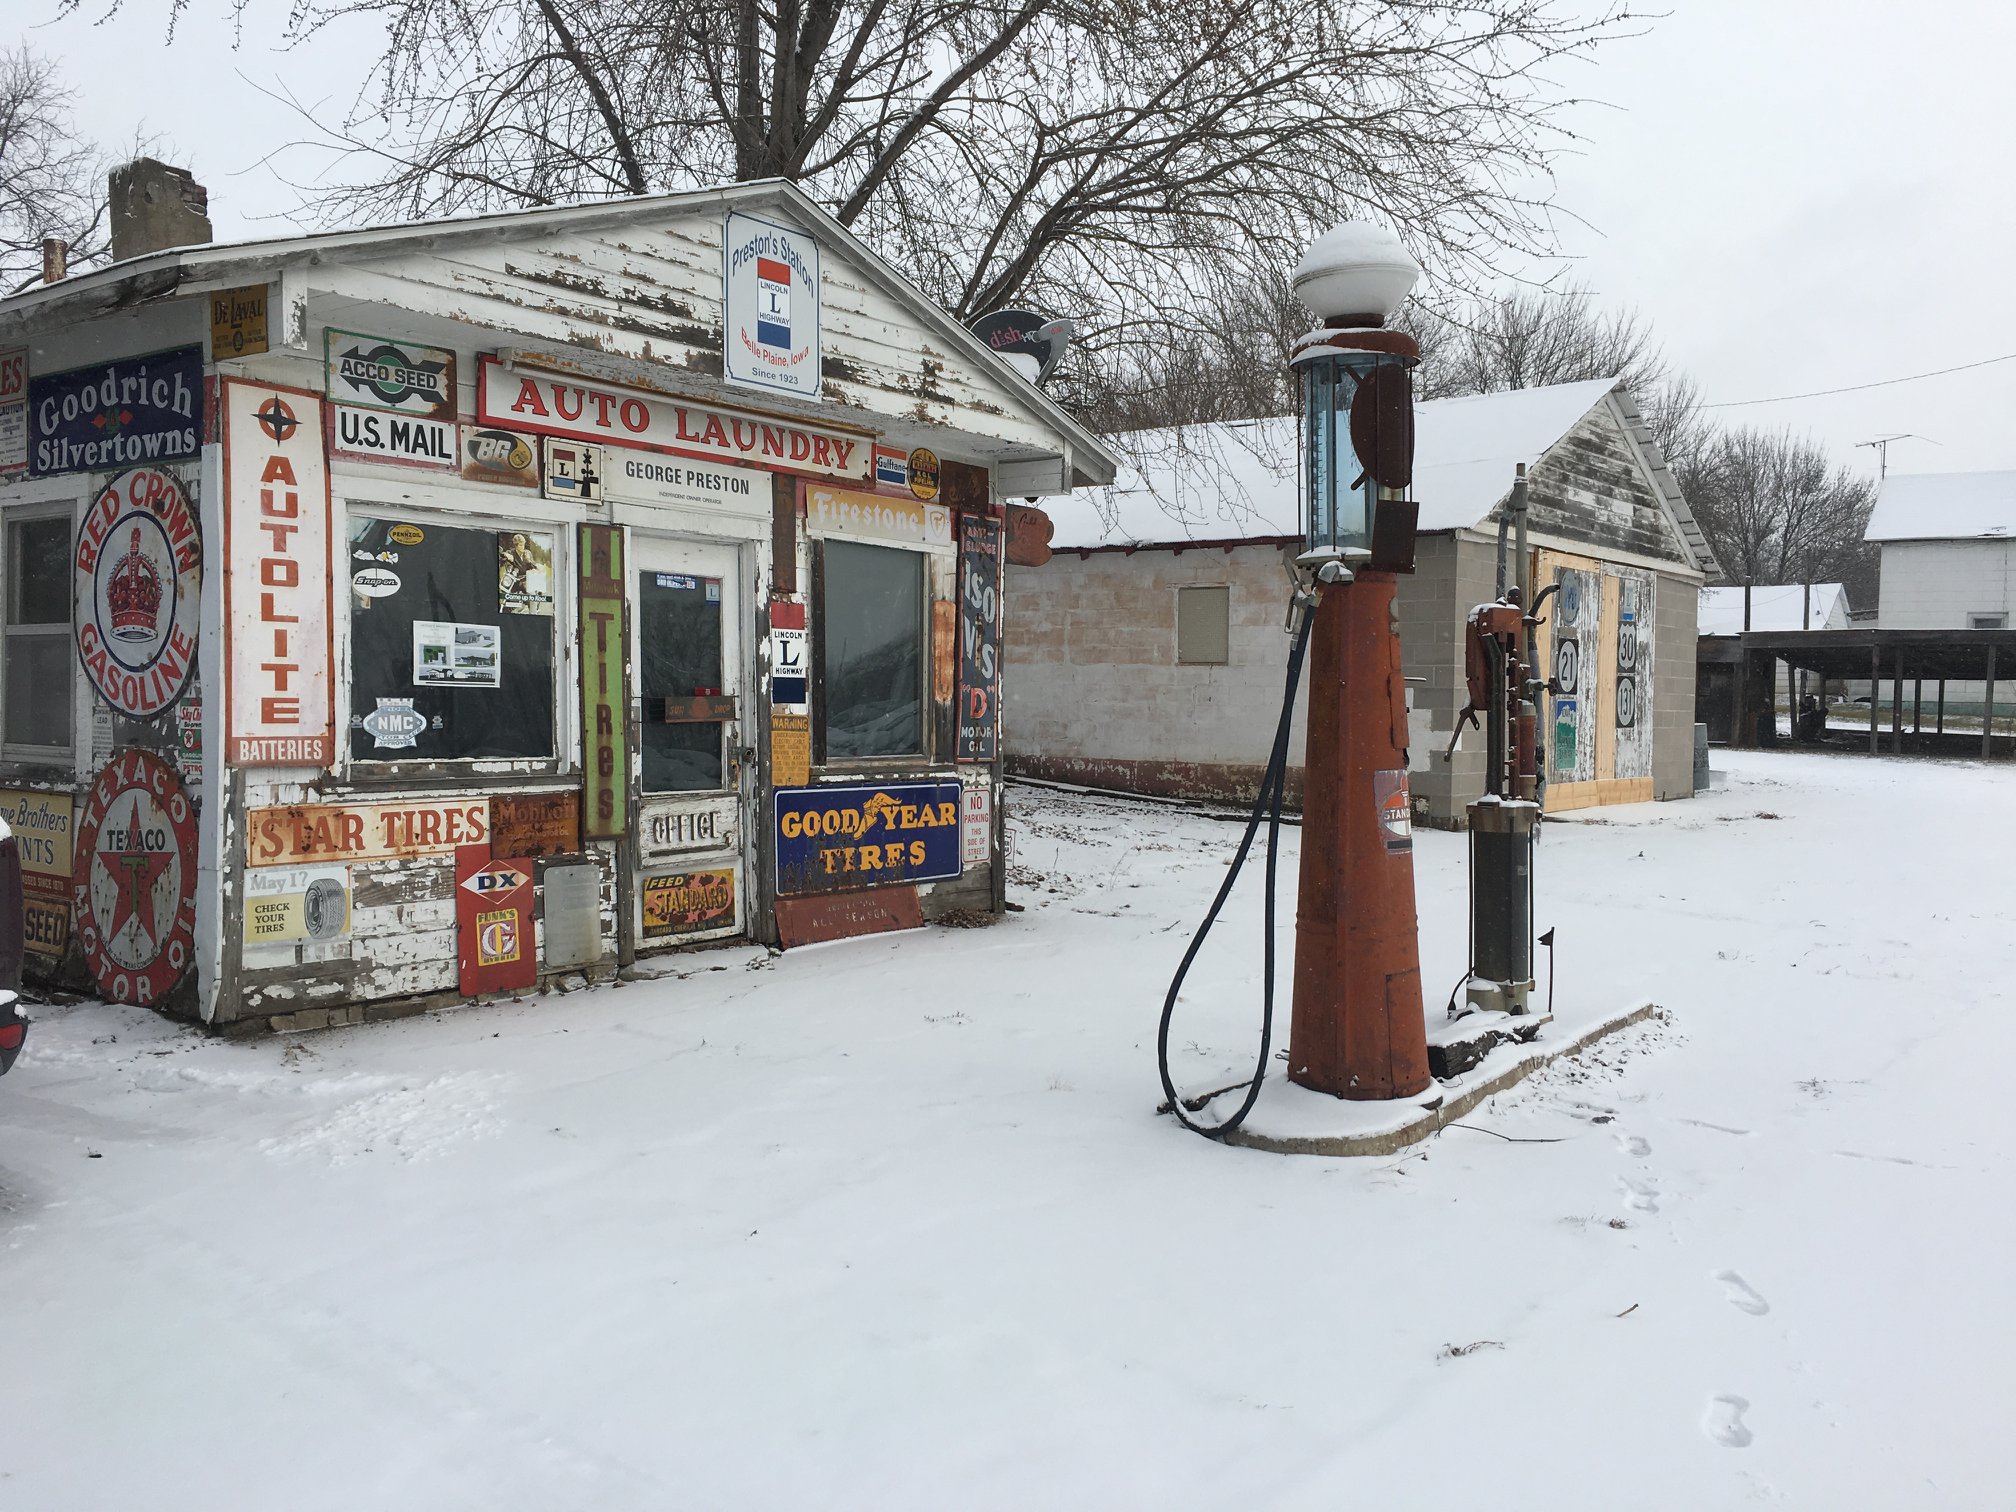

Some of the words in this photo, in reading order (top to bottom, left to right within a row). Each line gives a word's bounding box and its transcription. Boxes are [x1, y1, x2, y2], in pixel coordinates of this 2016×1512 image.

[732, 231, 778, 277] Preston's
[781, 236, 814, 298] Station
[760, 281, 788, 295] LINCOLN
[770, 293, 781, 314] L
[759, 312, 790, 326] HIGHWAY
[741, 326, 761, 359] Belle
[763, 349, 788, 368] Plaine,
[790, 345, 809, 365] Iowa
[990, 326, 1020, 348] dish
[340, 358, 389, 382] ACCO
[394, 371, 437, 390] SEED
[752, 367, 776, 380] Since
[779, 373, 799, 385] 1923
[39, 366, 193, 437] Goodrich
[510, 377, 651, 435] AUTO
[674, 407, 855, 470] LAUNDRY
[341, 411, 386, 449] U.S.
[390, 419, 452, 460] MAIL
[37, 424, 196, 471] Silvertowns
[559, 462, 570, 477] L
[878, 456, 906, 472] Gulftane
[625, 460, 682, 485] GEORGE
[686, 470, 750, 495] PRESTON
[814, 491, 919, 532] Firestone
[77, 489, 120, 575] RED
[128, 471, 199, 575] CROWN
[965, 541, 997, 554] SLUDGE
[259, 455, 300, 724] AUTOLITE
[774, 631, 802, 639] LINCOLN
[780, 640, 800, 666] L
[1620, 632, 1634, 662] 30
[81, 622, 194, 711] GASOLINE
[775, 667, 803, 675] HIGHWAY
[1561, 652, 1574, 681] 21
[1619, 683, 1632, 716] 131
[378, 715, 413, 732] NMC
[772, 718, 808, 730] WARNING
[961, 726, 992, 738] MOTOR
[240, 740, 322, 761] BATTERIES
[968, 740, 985, 752] OIL
[86, 755, 187, 830] TEXACO
[970, 796, 982, 810] NO
[16, 798, 67, 832] Brothers
[964, 813, 989, 824] PARKING
[259, 814, 366, 859] STAR
[380, 806, 486, 849] TIRES
[653, 810, 722, 844] OFFICE
[971, 828, 982, 836] THIS
[106, 828, 166, 851] TEXACO
[967, 838, 977, 846] SIDE
[979, 837, 985, 845] OF
[820, 840, 926, 875] TIRES
[968, 848, 985, 856] STREET
[250, 875, 287, 893] May
[477, 872, 517, 891] DX
[650, 876, 684, 888] FEED
[255, 902, 290, 913] CHECK
[654, 884, 729, 915] STANDARD
[25, 907, 65, 946] SEED
[255, 913, 285, 923] YOUR
[478, 909, 516, 923] FUNK'S
[255, 923, 285, 934] TIRES
[74, 884, 153, 1003] MOTOR
